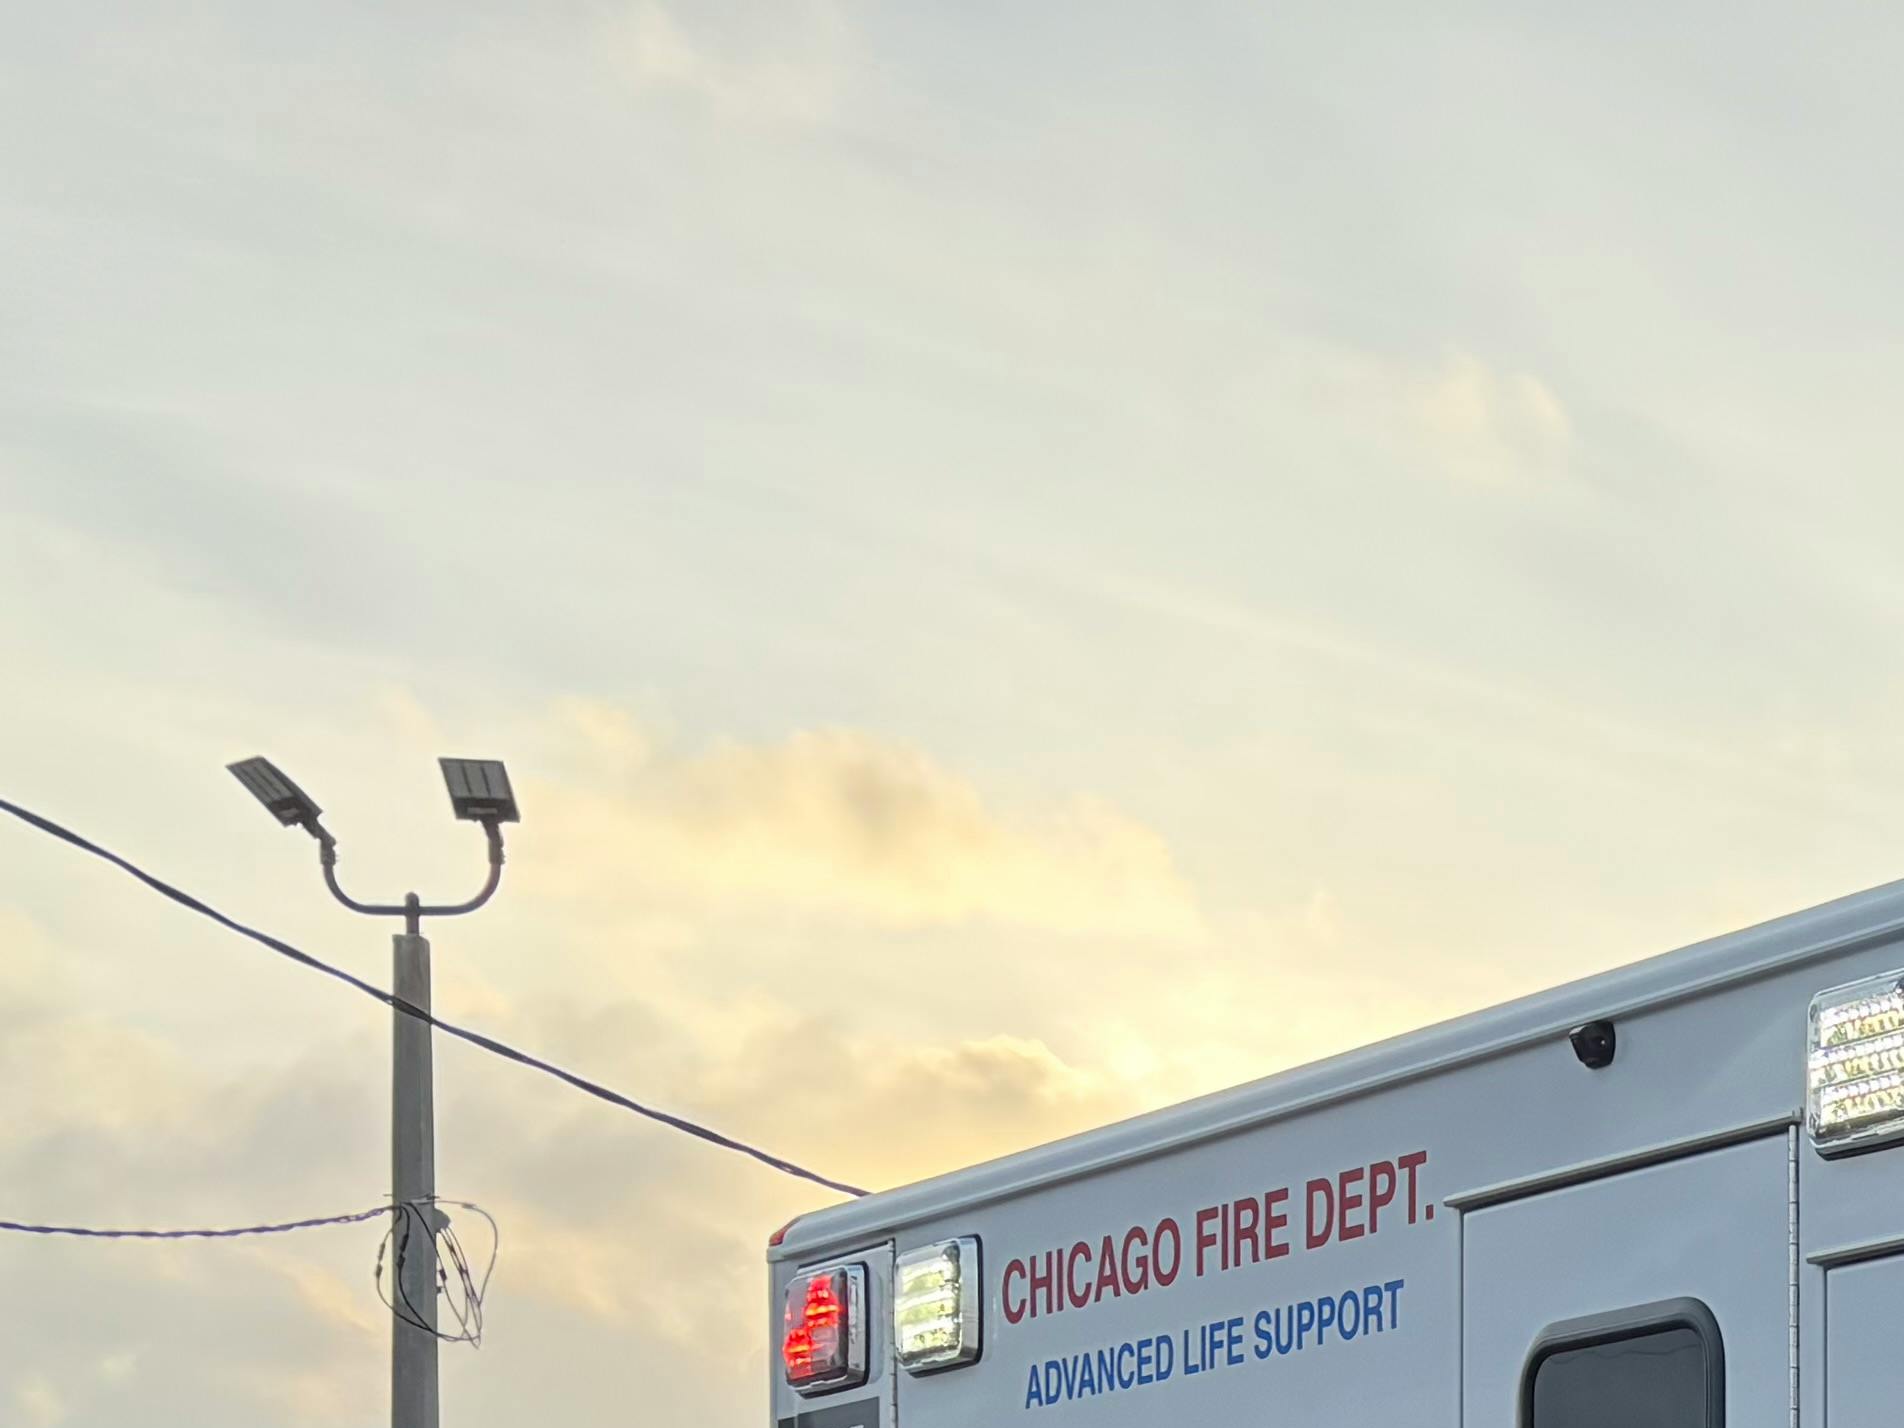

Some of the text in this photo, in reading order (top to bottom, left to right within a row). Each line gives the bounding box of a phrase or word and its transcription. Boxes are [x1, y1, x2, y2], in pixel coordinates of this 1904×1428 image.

[1001, 1150, 1434, 1325] CHICAGO FIRE DEPT.
[1025, 1279, 1405, 1410] ADVANCED LIFE SUPPORT
